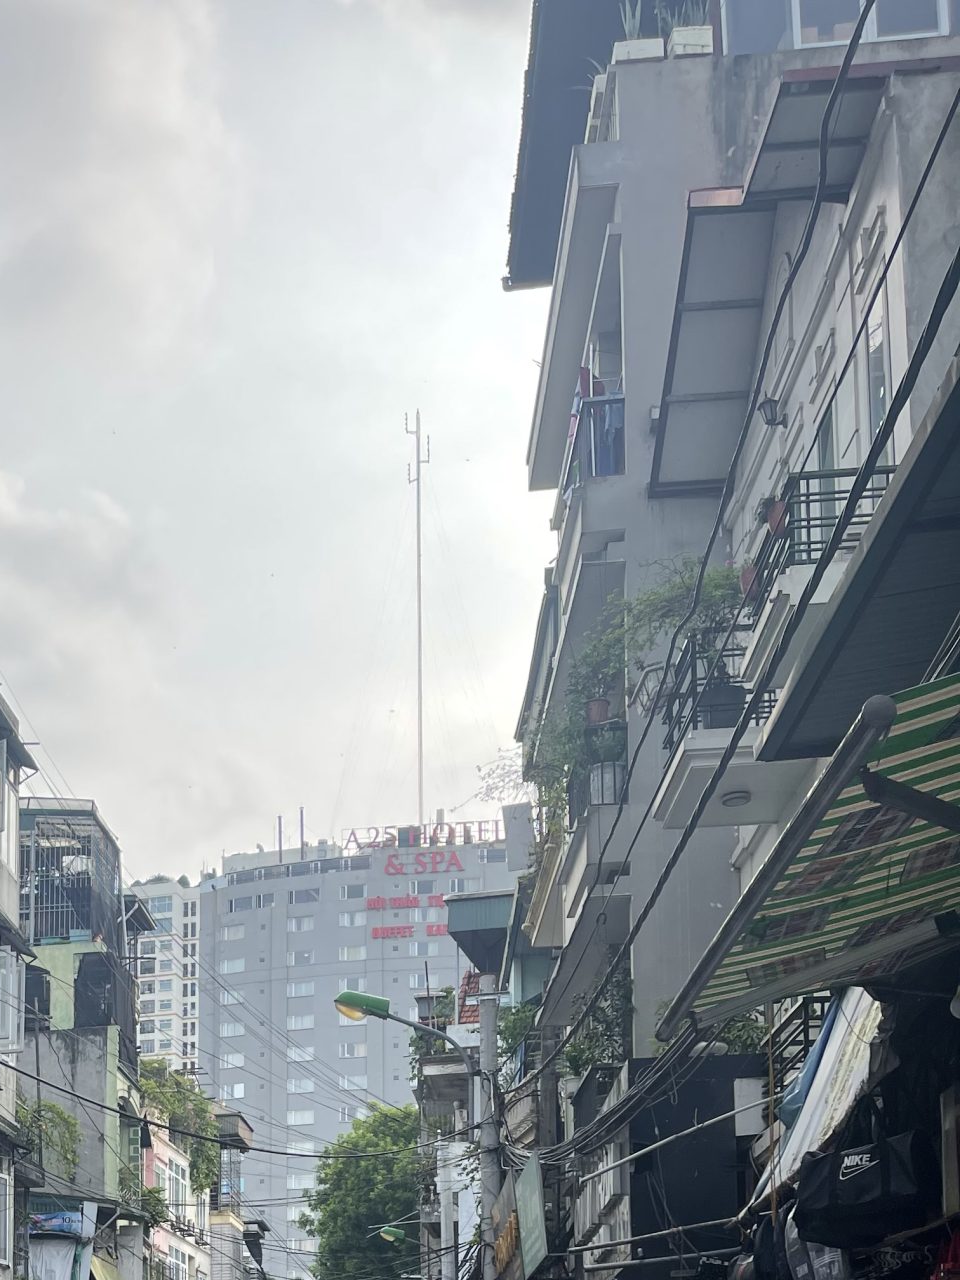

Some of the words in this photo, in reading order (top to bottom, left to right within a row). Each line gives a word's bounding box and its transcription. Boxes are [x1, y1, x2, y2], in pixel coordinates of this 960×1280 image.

[384, 853, 405, 875] &
[414, 850, 465, 874] SPA
[843, 1154, 871, 1166] NIKE
